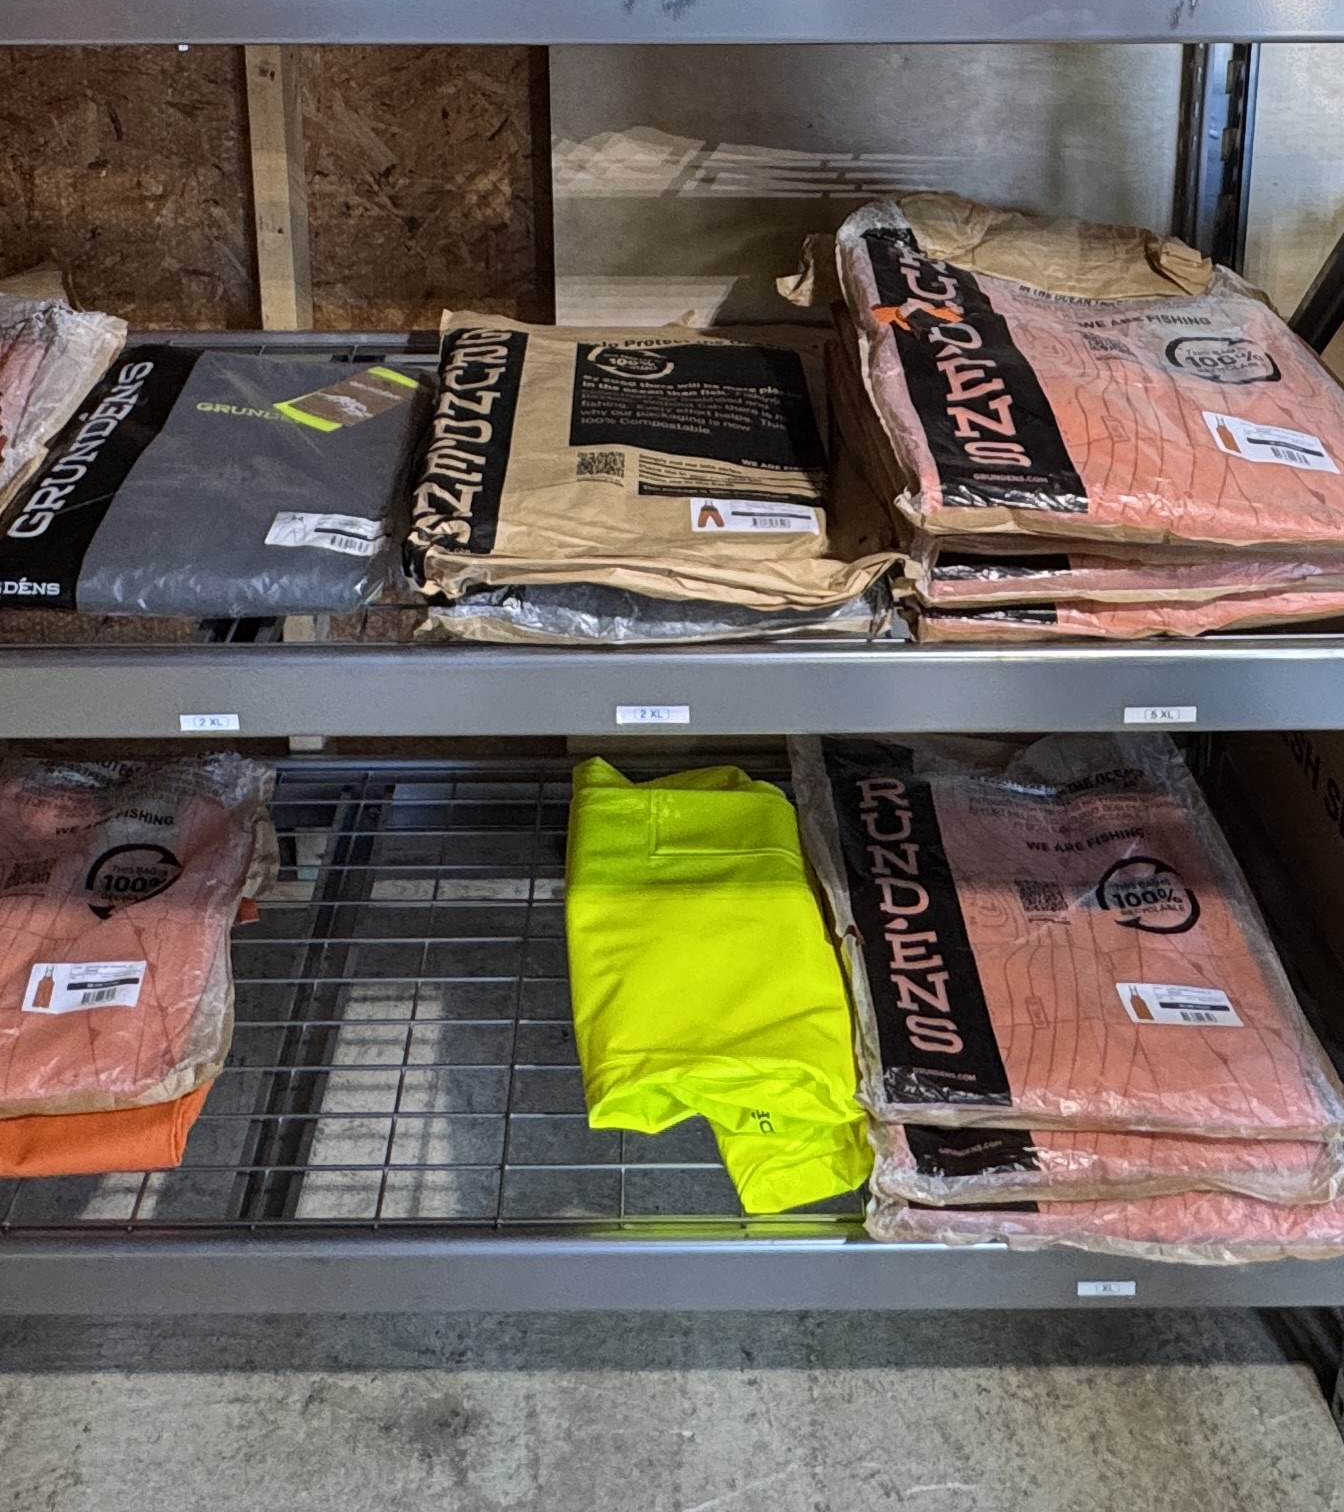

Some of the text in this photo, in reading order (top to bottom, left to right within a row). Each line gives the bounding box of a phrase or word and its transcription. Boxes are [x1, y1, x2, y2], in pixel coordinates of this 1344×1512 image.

[1145, 314, 1212, 326] FISHING
[7, 360, 155, 539] GRUNDÉNS
[199, 718, 223, 727] 2 XL
[640, 709, 664, 719] 2 XL
[1026, 827, 1145, 853] WE ARE FISHING
[1111, 889, 1183, 909] 100%
[855, 775, 964, 1055] RUNDÉNS
